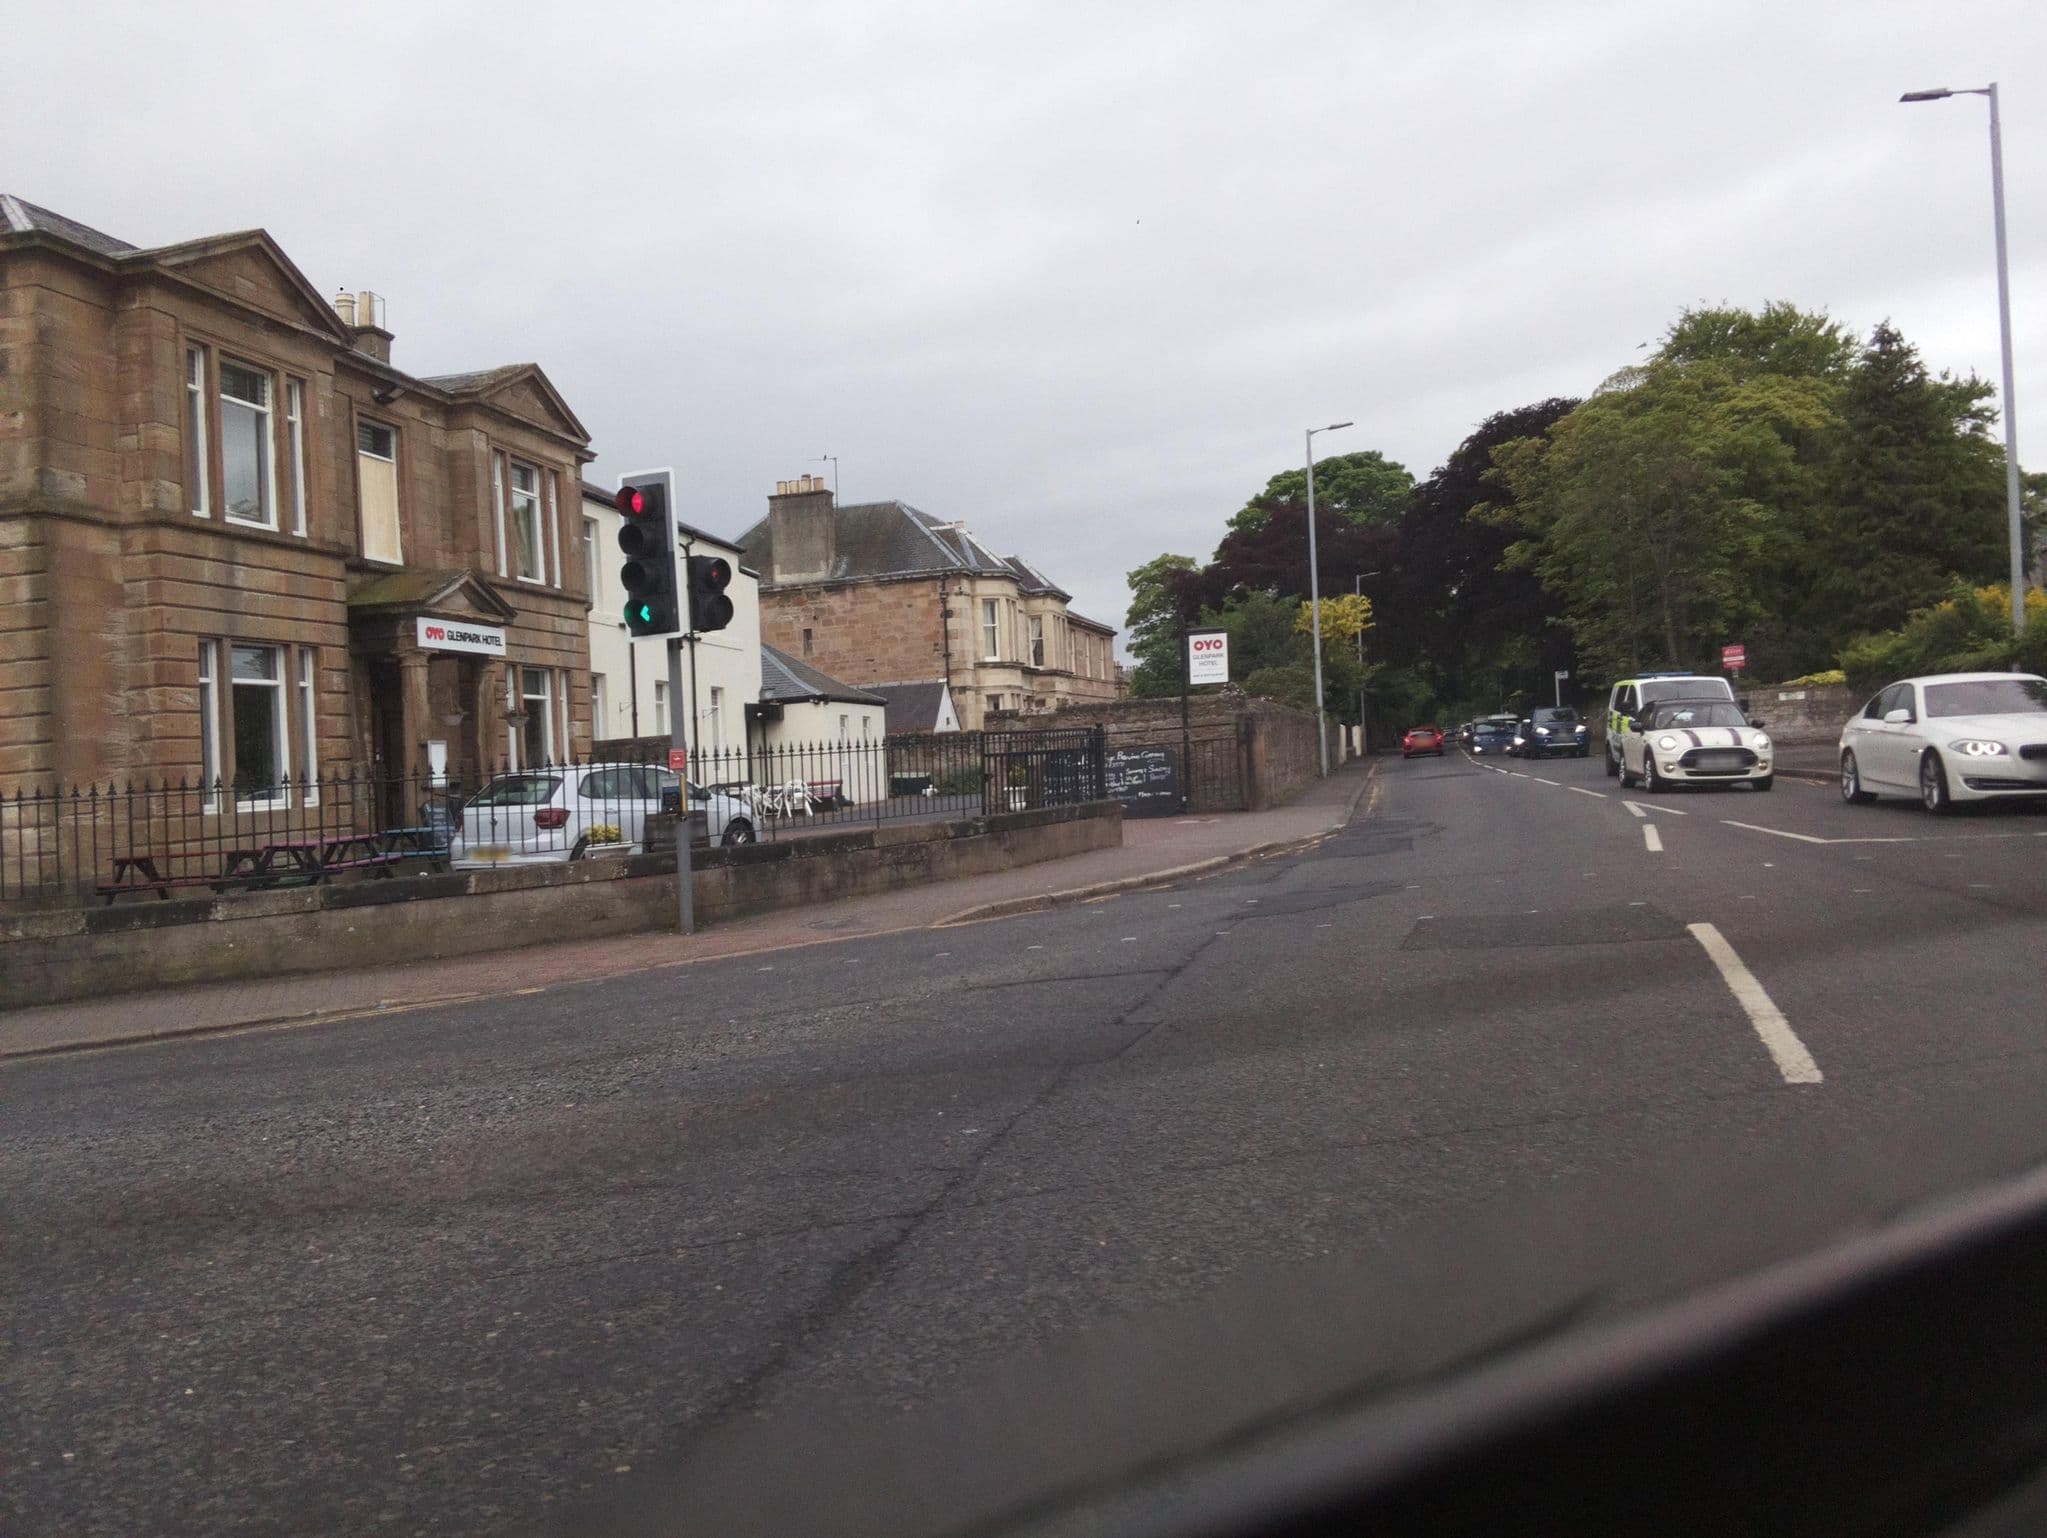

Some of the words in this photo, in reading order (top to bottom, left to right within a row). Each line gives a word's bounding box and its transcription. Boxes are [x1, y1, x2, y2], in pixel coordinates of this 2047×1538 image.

[426, 626, 445, 640] OYO
[447, 630, 482, 644] GLENPARK
[482, 634, 503, 647] HOTEL
[1194, 639, 1223, 651] OYO
